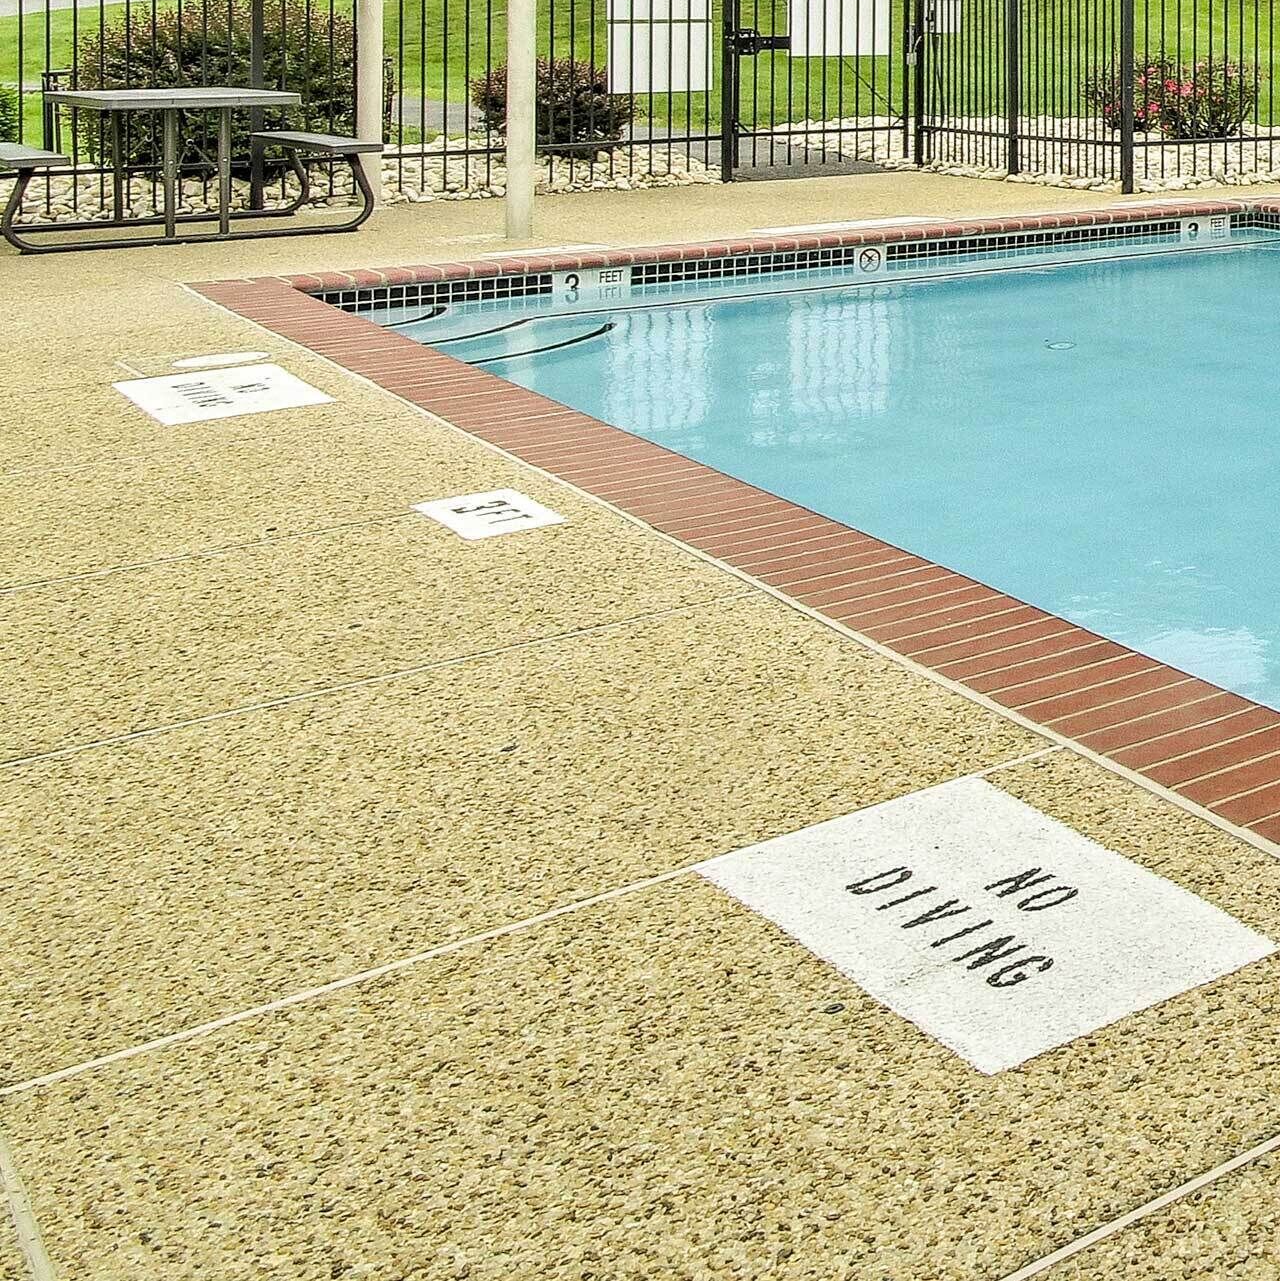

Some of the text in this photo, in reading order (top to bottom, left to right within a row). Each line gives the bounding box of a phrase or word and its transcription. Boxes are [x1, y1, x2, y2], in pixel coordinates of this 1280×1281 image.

[565, 269, 624, 290] 3 FEET
[450, 500, 534, 525] 3FT
[984, 866, 1079, 912] NO
[845, 865, 1055, 988] DIVING
